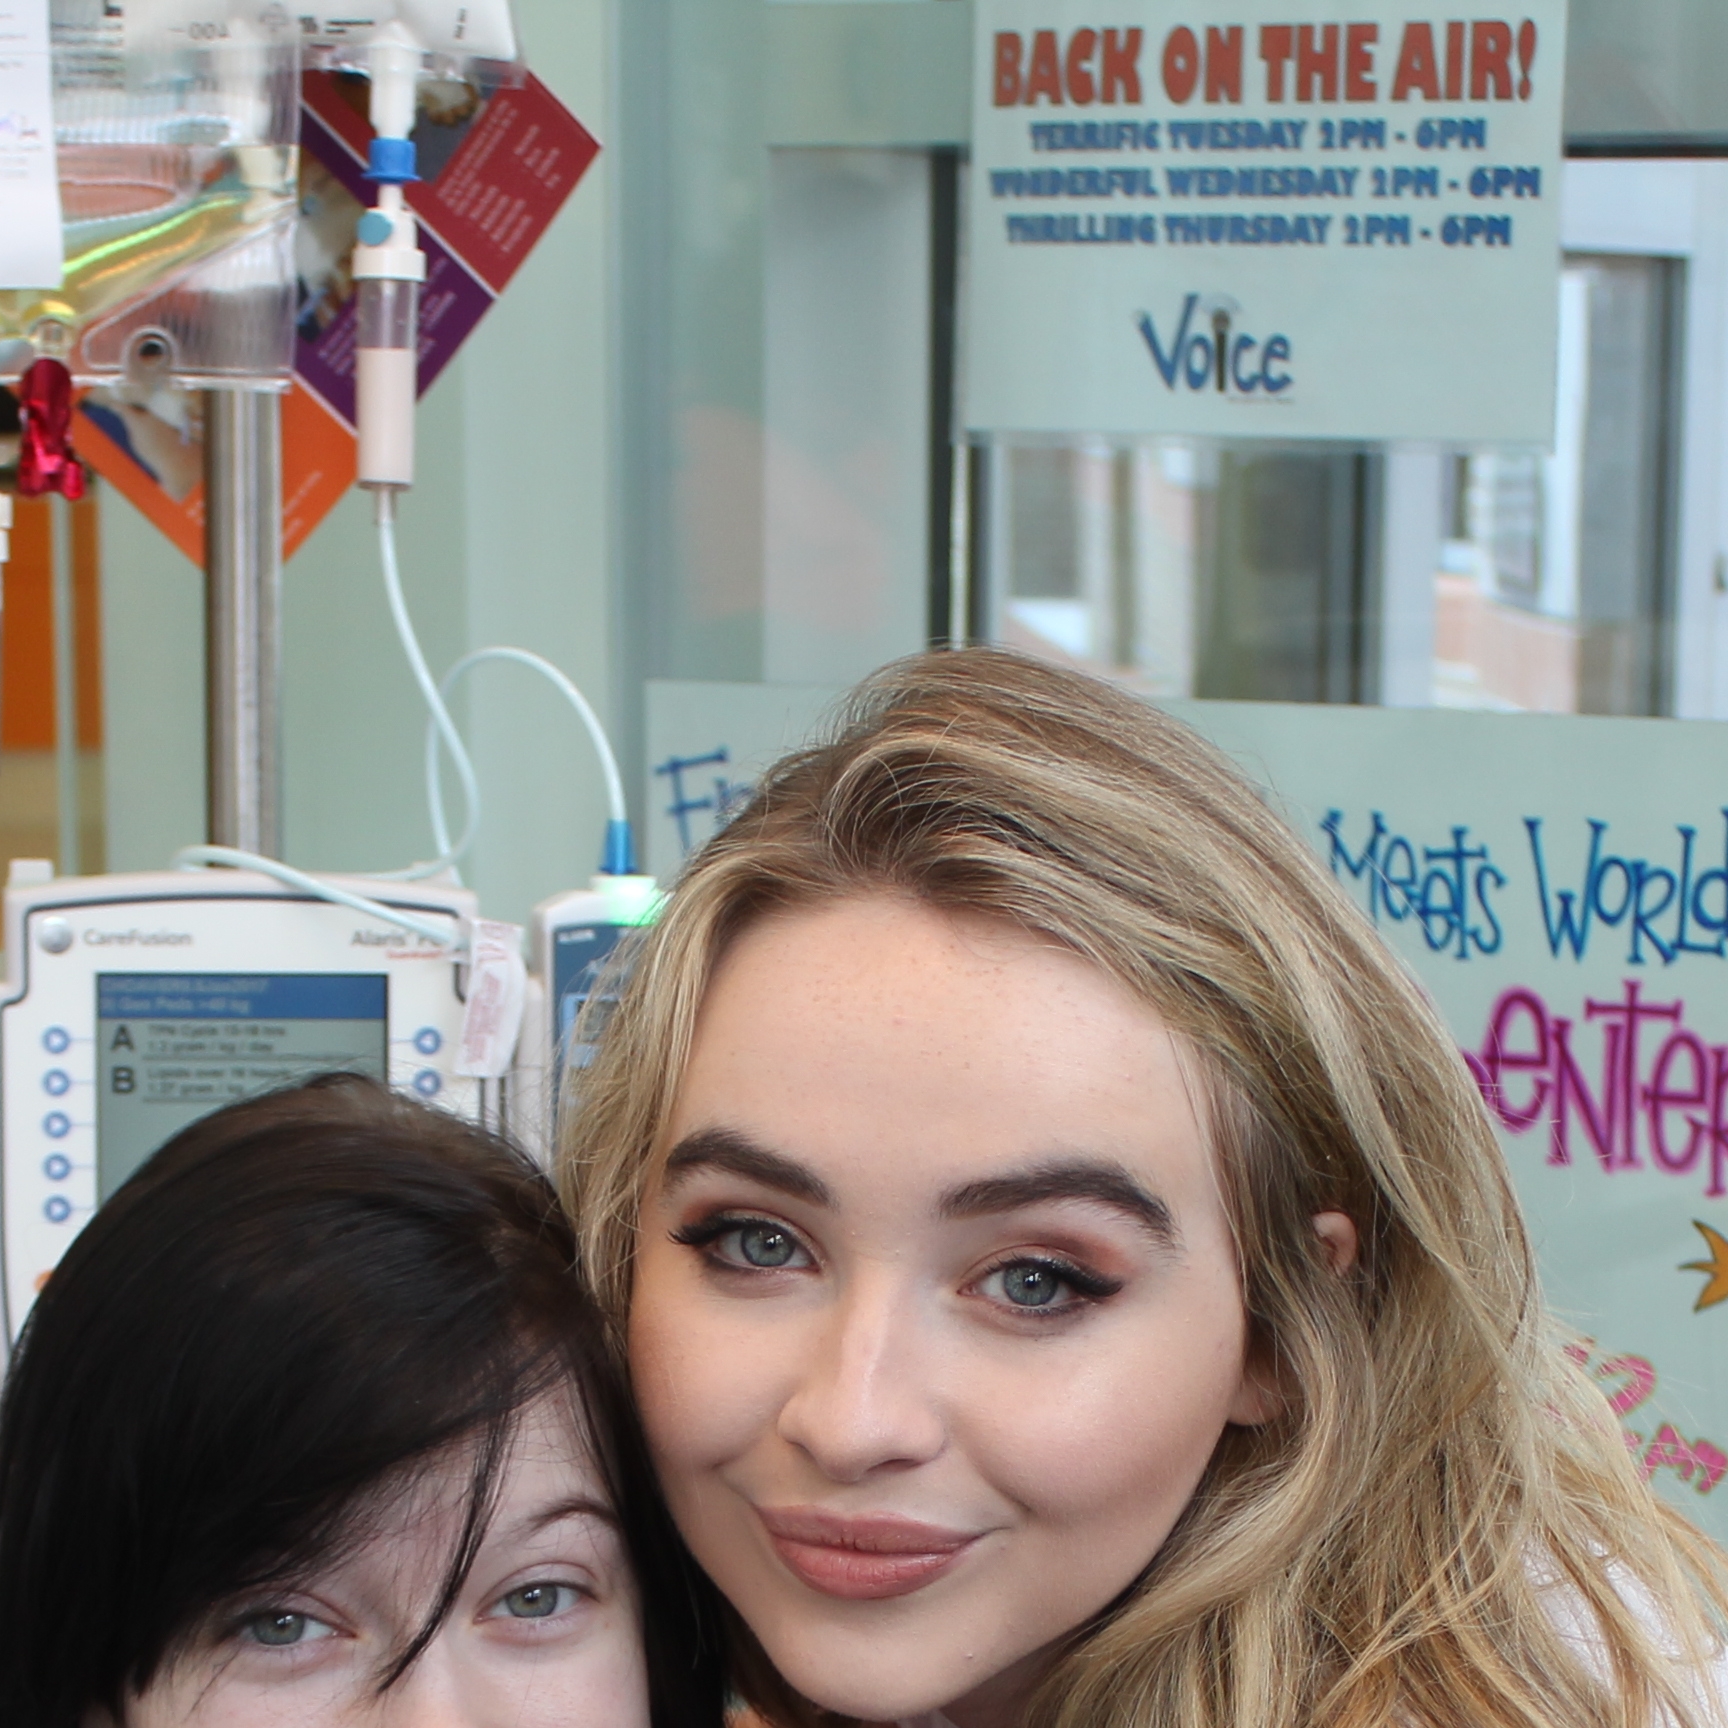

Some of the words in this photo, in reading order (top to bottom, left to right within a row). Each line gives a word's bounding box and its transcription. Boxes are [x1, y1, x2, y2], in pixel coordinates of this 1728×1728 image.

[992, 27, 1144, 107] BACK
[1161, 24, 1244, 105] ON
[1258, 22, 1379, 103] THE
[1390, 18, 1537, 102] AIR!
[1029, 119, 1160, 152] TERRIFIC
[1166, 117, 1307, 151] TUESDAY
[1318, 117, 1387, 150] 2PM
[1415, 117, 1487, 150] 6PM
[987, 167, 1160, 198] WONDERFUL
[1163, 166, 1360, 198] WEDNESDAY
[1370, 165, 1440, 198] 2PM
[1468, 165, 1542, 198] 6PM
[1005, 214, 1158, 246] THRILLING
[1164, 213, 1333, 246] THURSDAY
[1342, 213, 1412, 246] 2PM
[1440, 213, 1513, 247] 6PM
[1134, 293, 1294, 393] Voice
[82, 926, 195, 949] CareFusion
[109, 1022, 136, 1053] A
[110, 1065, 137, 1095] B
